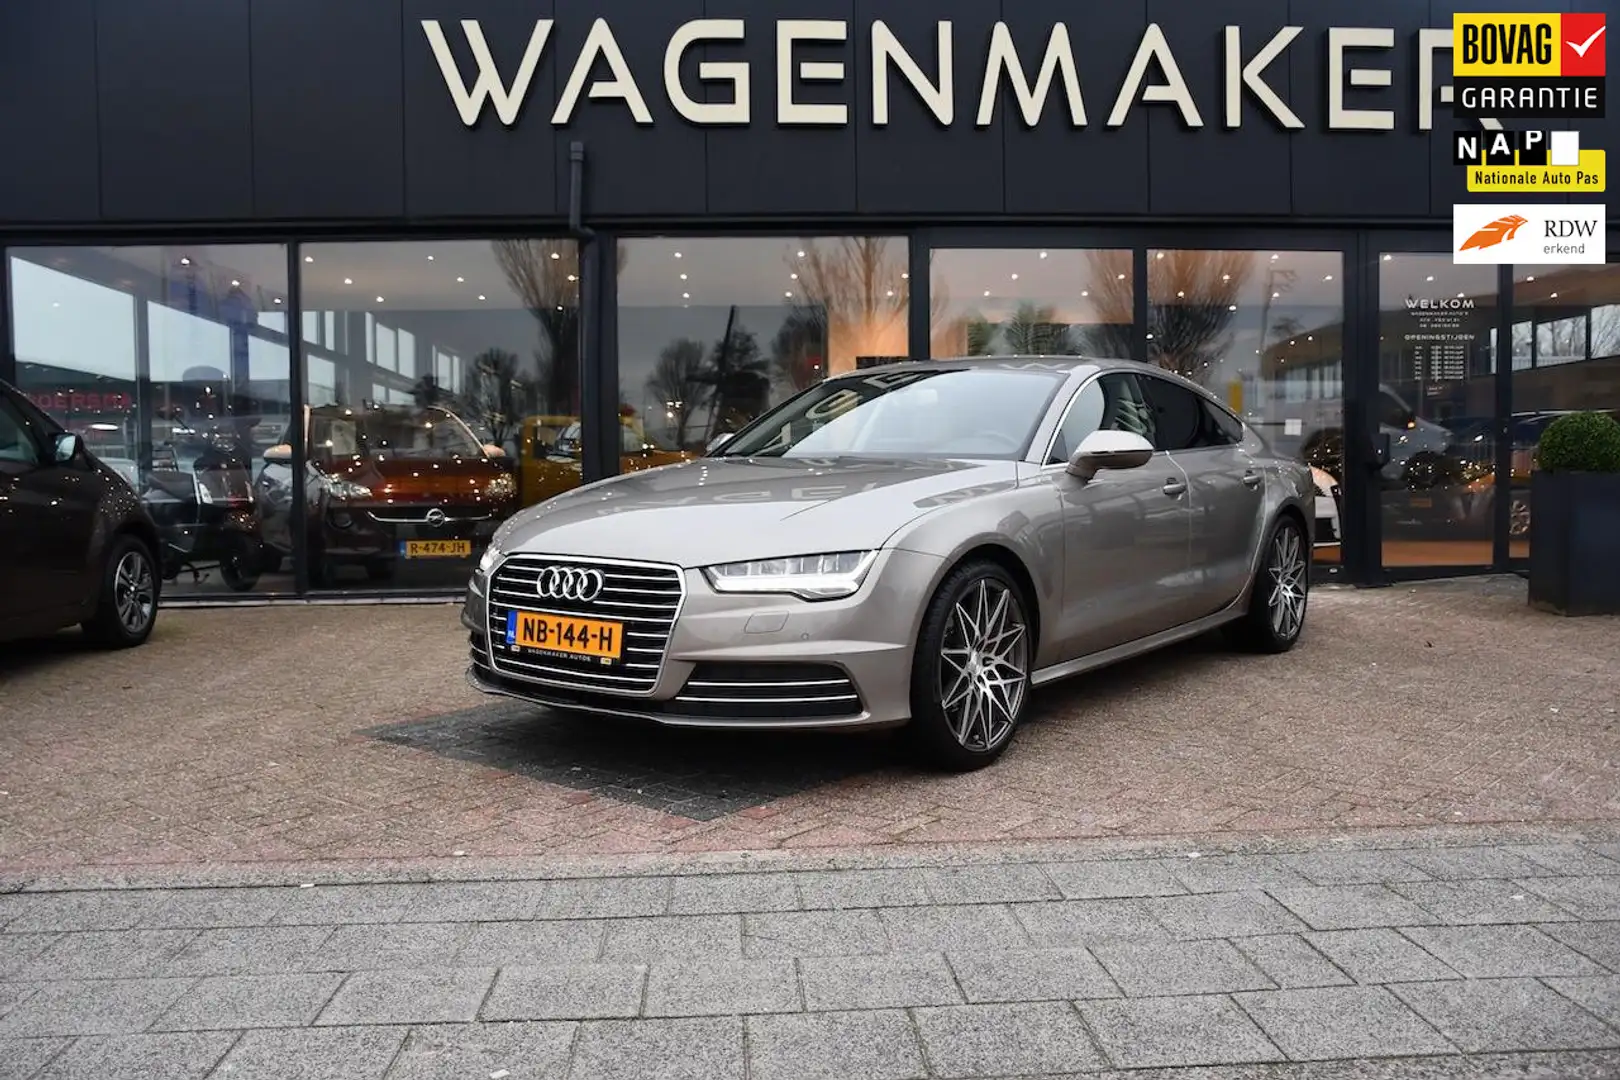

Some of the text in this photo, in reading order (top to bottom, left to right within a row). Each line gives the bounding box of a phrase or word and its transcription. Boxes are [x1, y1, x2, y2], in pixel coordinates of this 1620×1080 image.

[1405, 299, 1475, 309] WELKOM
[410, 542, 465, 554] R-474-JH
[523, 617, 613, 652] NB-144-H
